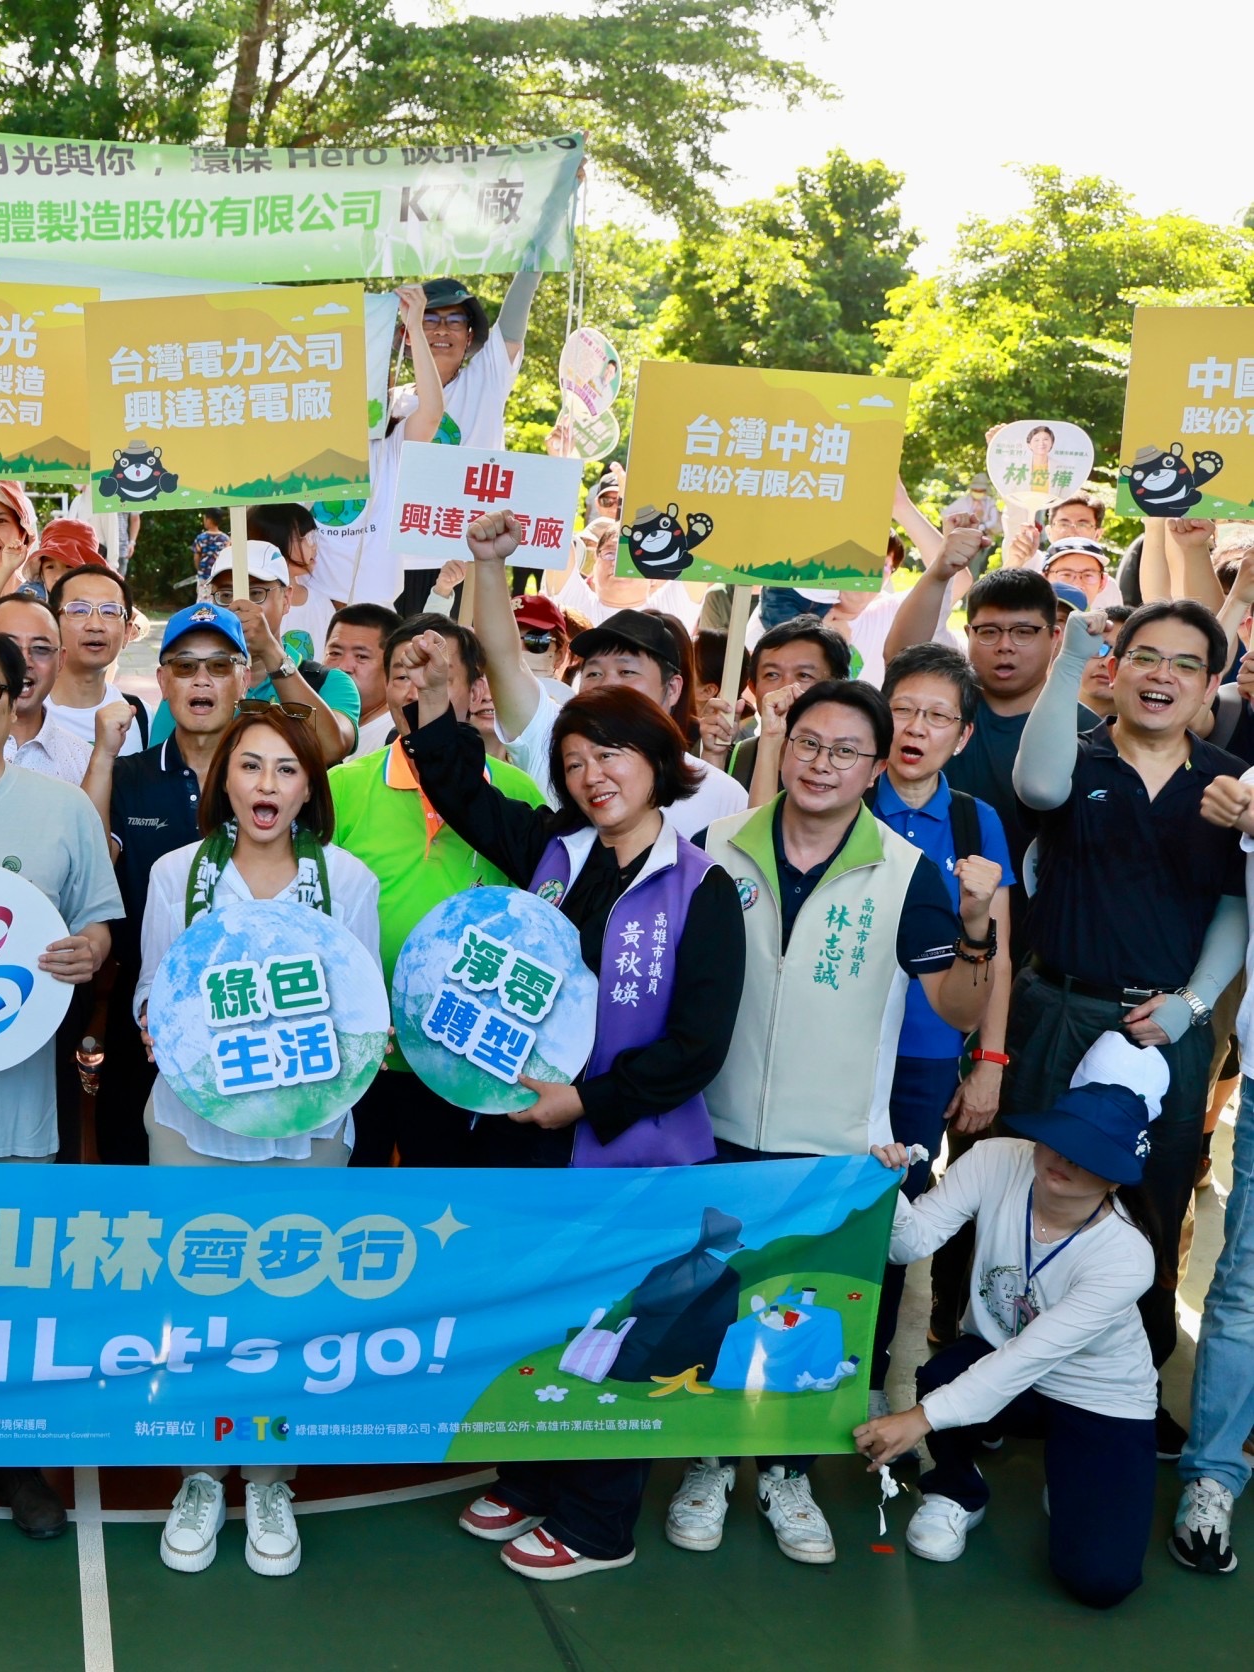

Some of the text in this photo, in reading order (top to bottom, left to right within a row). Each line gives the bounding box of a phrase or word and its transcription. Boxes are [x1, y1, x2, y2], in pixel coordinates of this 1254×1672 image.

[108, 332, 344, 387] 台灣電力公司
[122, 379, 334, 433] 興達發電廠
[684, 415, 852, 466] 台灣中油
[677, 464, 845, 502] 股份有限公司
[327, 528, 339, 536] no
[370, 524, 377, 533] B
[399, 502, 565, 549] 興達廠
[610, 920, 645, 1008] 黃秋媖
[646, 912, 668, 996] 高雄市議員
[813, 904, 853, 991] 林志誠
[848, 897, 876, 979] 高雄市議員
[206, 959, 323, 1020] 綠色
[451, 931, 557, 1017] 淨零
[217, 1022, 334, 1089] 生活
[427, 990, 530, 1077] 轉型
[32, 1315, 283, 1382] Let's
[302, 1316, 457, 1395] go!
[13, 1432, 36, 1440] Bureau
[37, 1432, 70, 1441] Kaohsiung
[134, 1420, 196, 1437] 執行單位
